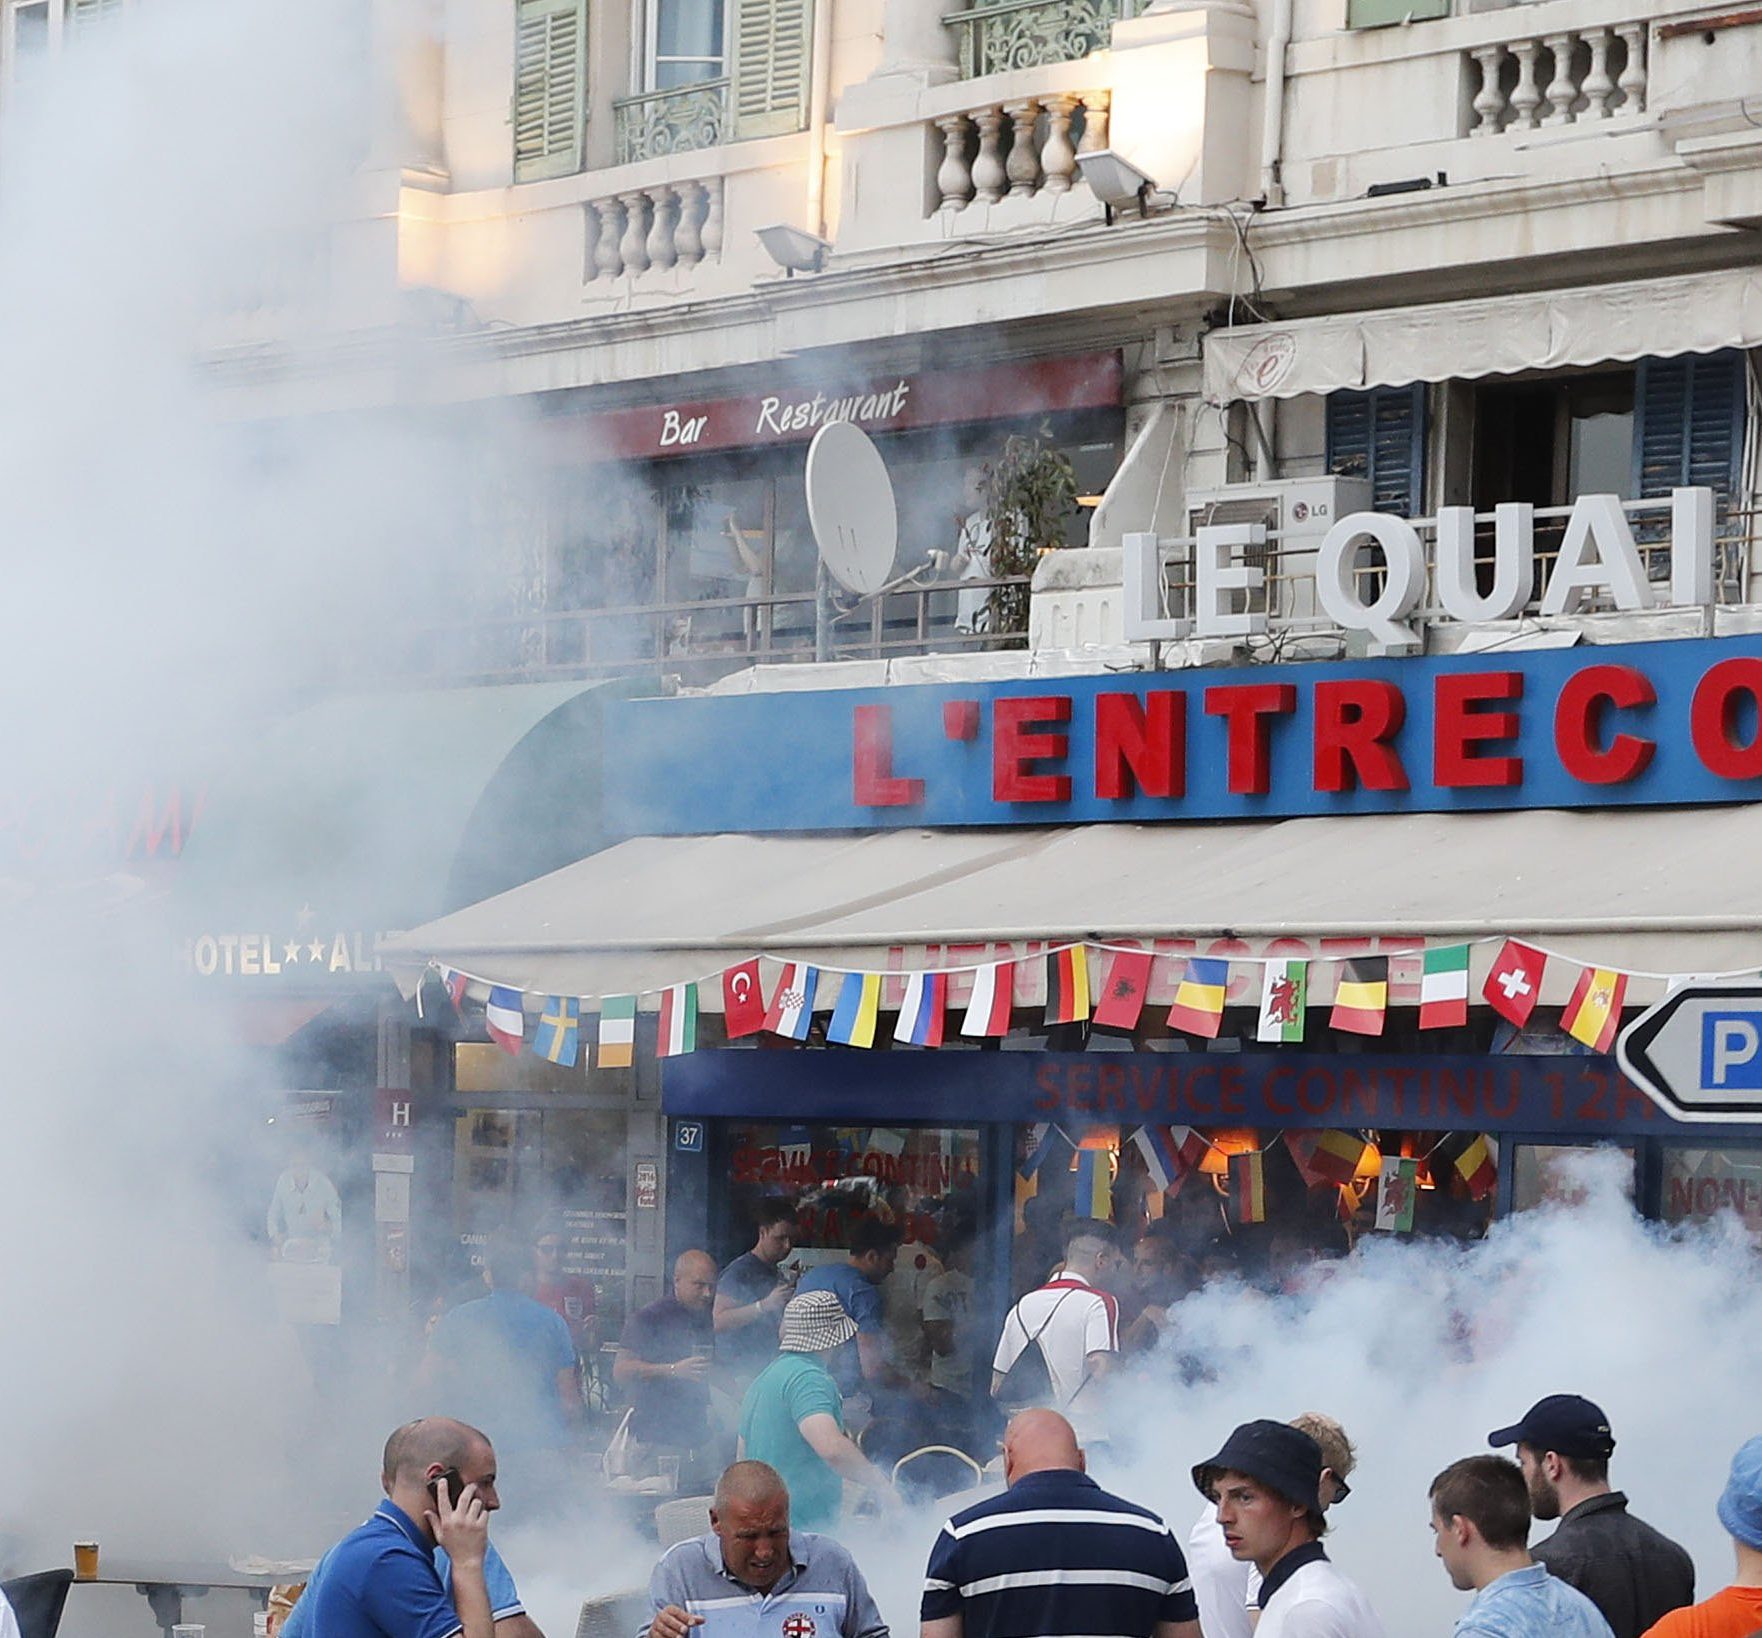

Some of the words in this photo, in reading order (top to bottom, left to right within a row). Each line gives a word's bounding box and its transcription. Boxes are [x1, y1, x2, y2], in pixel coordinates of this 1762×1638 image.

[659, 410, 707, 446] Bar
[756, 380, 909, 435] Restaurant
[1311, 504, 1328, 517] LG
[1122, 523, 1266, 642] LE
[1316, 486, 1717, 656] QUAI
[183, 932, 282, 975] OTEL
[1713, 1020, 1759, 1084] P
[392, 1101, 411, 1127] H
[1036, 1063, 1245, 1115] SERVICE
[1260, 1067, 1521, 1119] CONTINU
[680, 1126, 698, 1145] 37
